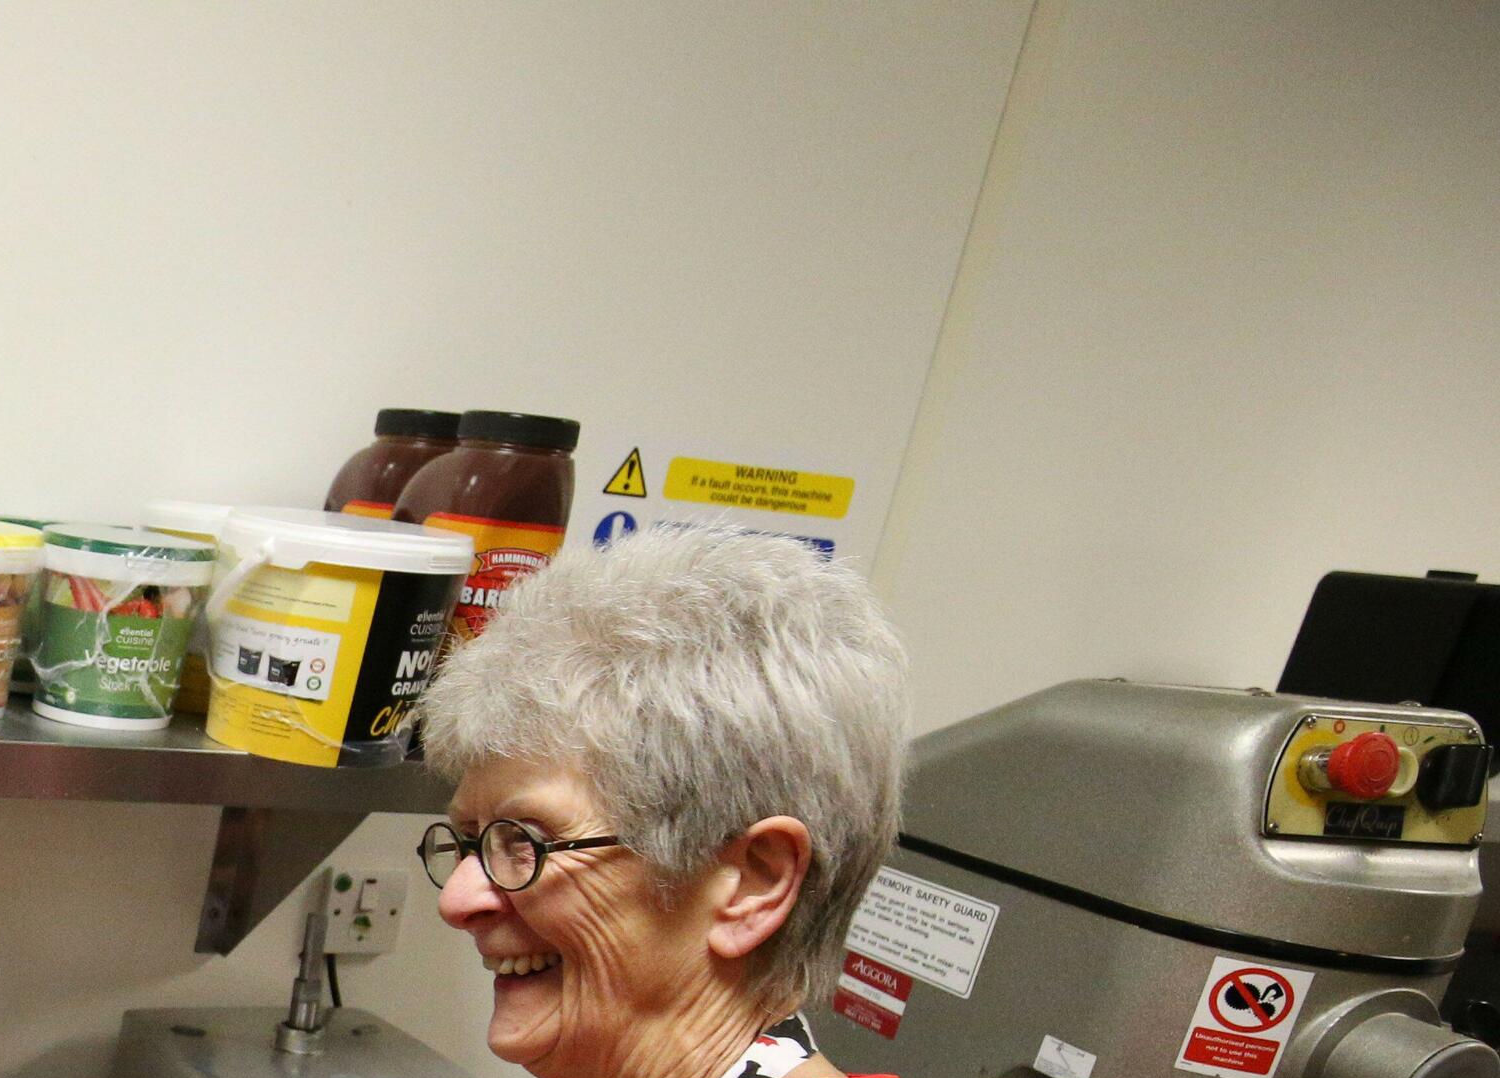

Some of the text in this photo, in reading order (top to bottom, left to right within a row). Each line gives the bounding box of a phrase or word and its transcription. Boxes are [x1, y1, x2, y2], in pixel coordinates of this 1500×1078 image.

[735, 464, 798, 484] WARNING
[708, 476, 731, 489] fault
[771, 485, 789, 497] this
[791, 488, 832, 502] machine
[710, 491, 739, 504] could
[85, 649, 171, 674] Vegetable
[876, 875, 913, 895] REMOVE
[915, 889, 950, 909] SAFETY
[851, 958, 897, 990] AGGORA
[1195, 1031, 1245, 1048] Unauthorised
[1205, 1044, 1218, 1052] not
[1212, 1055, 1244, 1066] machine
